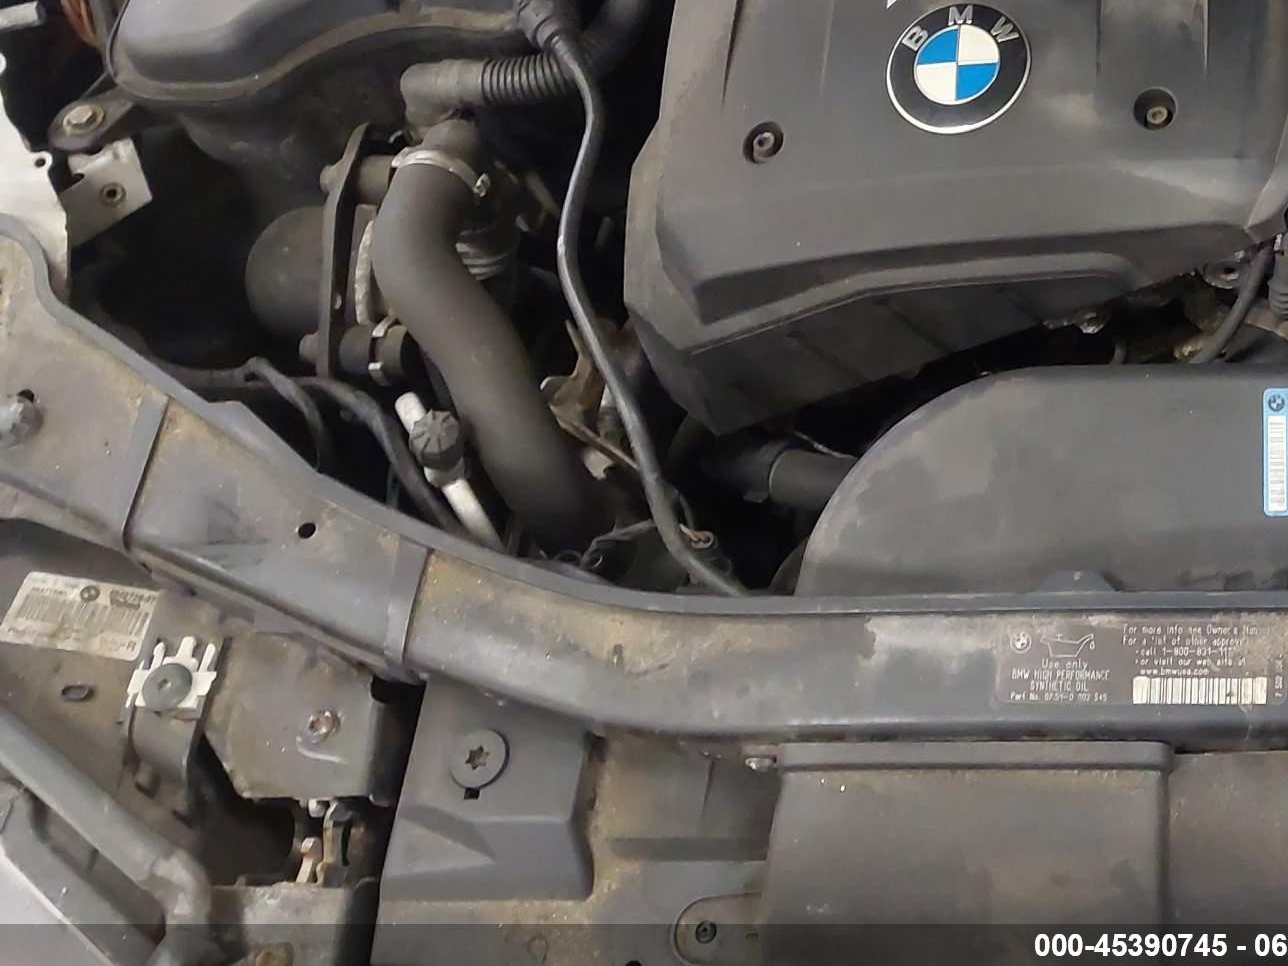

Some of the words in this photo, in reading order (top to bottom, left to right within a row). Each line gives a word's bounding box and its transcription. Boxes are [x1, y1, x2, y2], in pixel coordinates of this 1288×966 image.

[901, 4, 1020, 52] BMW
[1142, 626, 1162, 635] more
[1167, 624, 1184, 635] info
[1122, 635, 1137, 646] For
[1171, 636, 1181, 646] of
[1041, 658, 1060, 669] Use
[1065, 658, 1088, 671] only
[1011, 669, 1031, 680] BMW
[1034, 669, 1053, 681] HIGH
[1056, 669, 1111, 682] PERFORMANCE
[1030, 680, 1072, 692] SYNTHETIC
[1075, 680, 1089, 692] OIL
